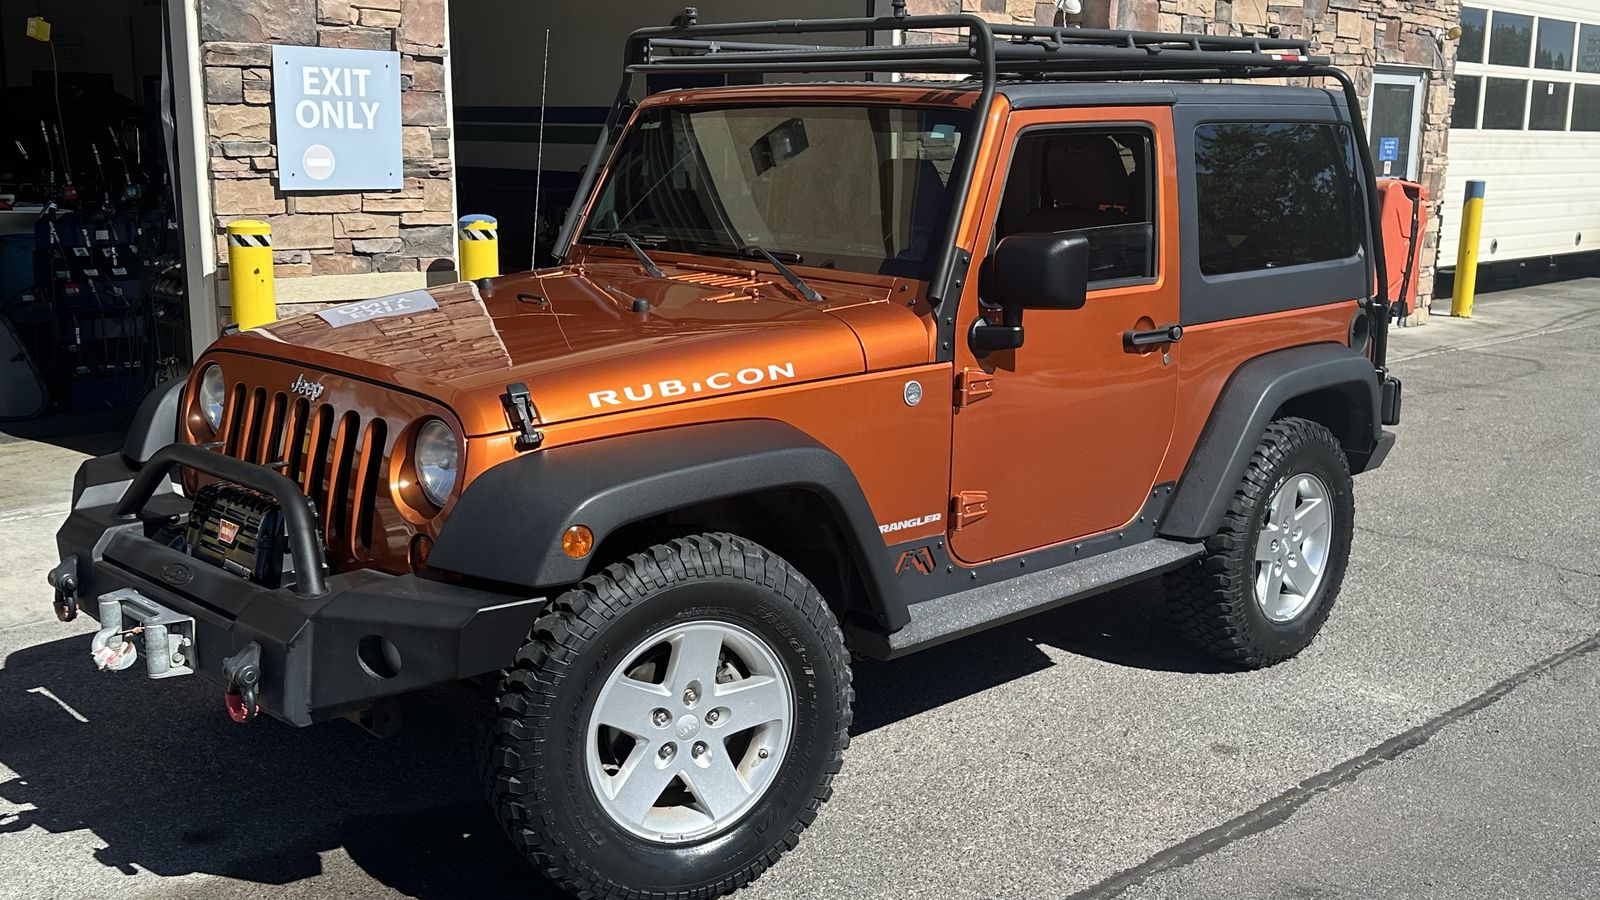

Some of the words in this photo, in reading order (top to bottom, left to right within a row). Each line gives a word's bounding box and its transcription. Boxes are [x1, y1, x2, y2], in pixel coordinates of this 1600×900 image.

[302, 66, 372, 97] EXIT
[295, 99, 381, 130] ONLY
[291, 373, 325, 401] Jeep
[878, 512, 942, 534] RANGLER
